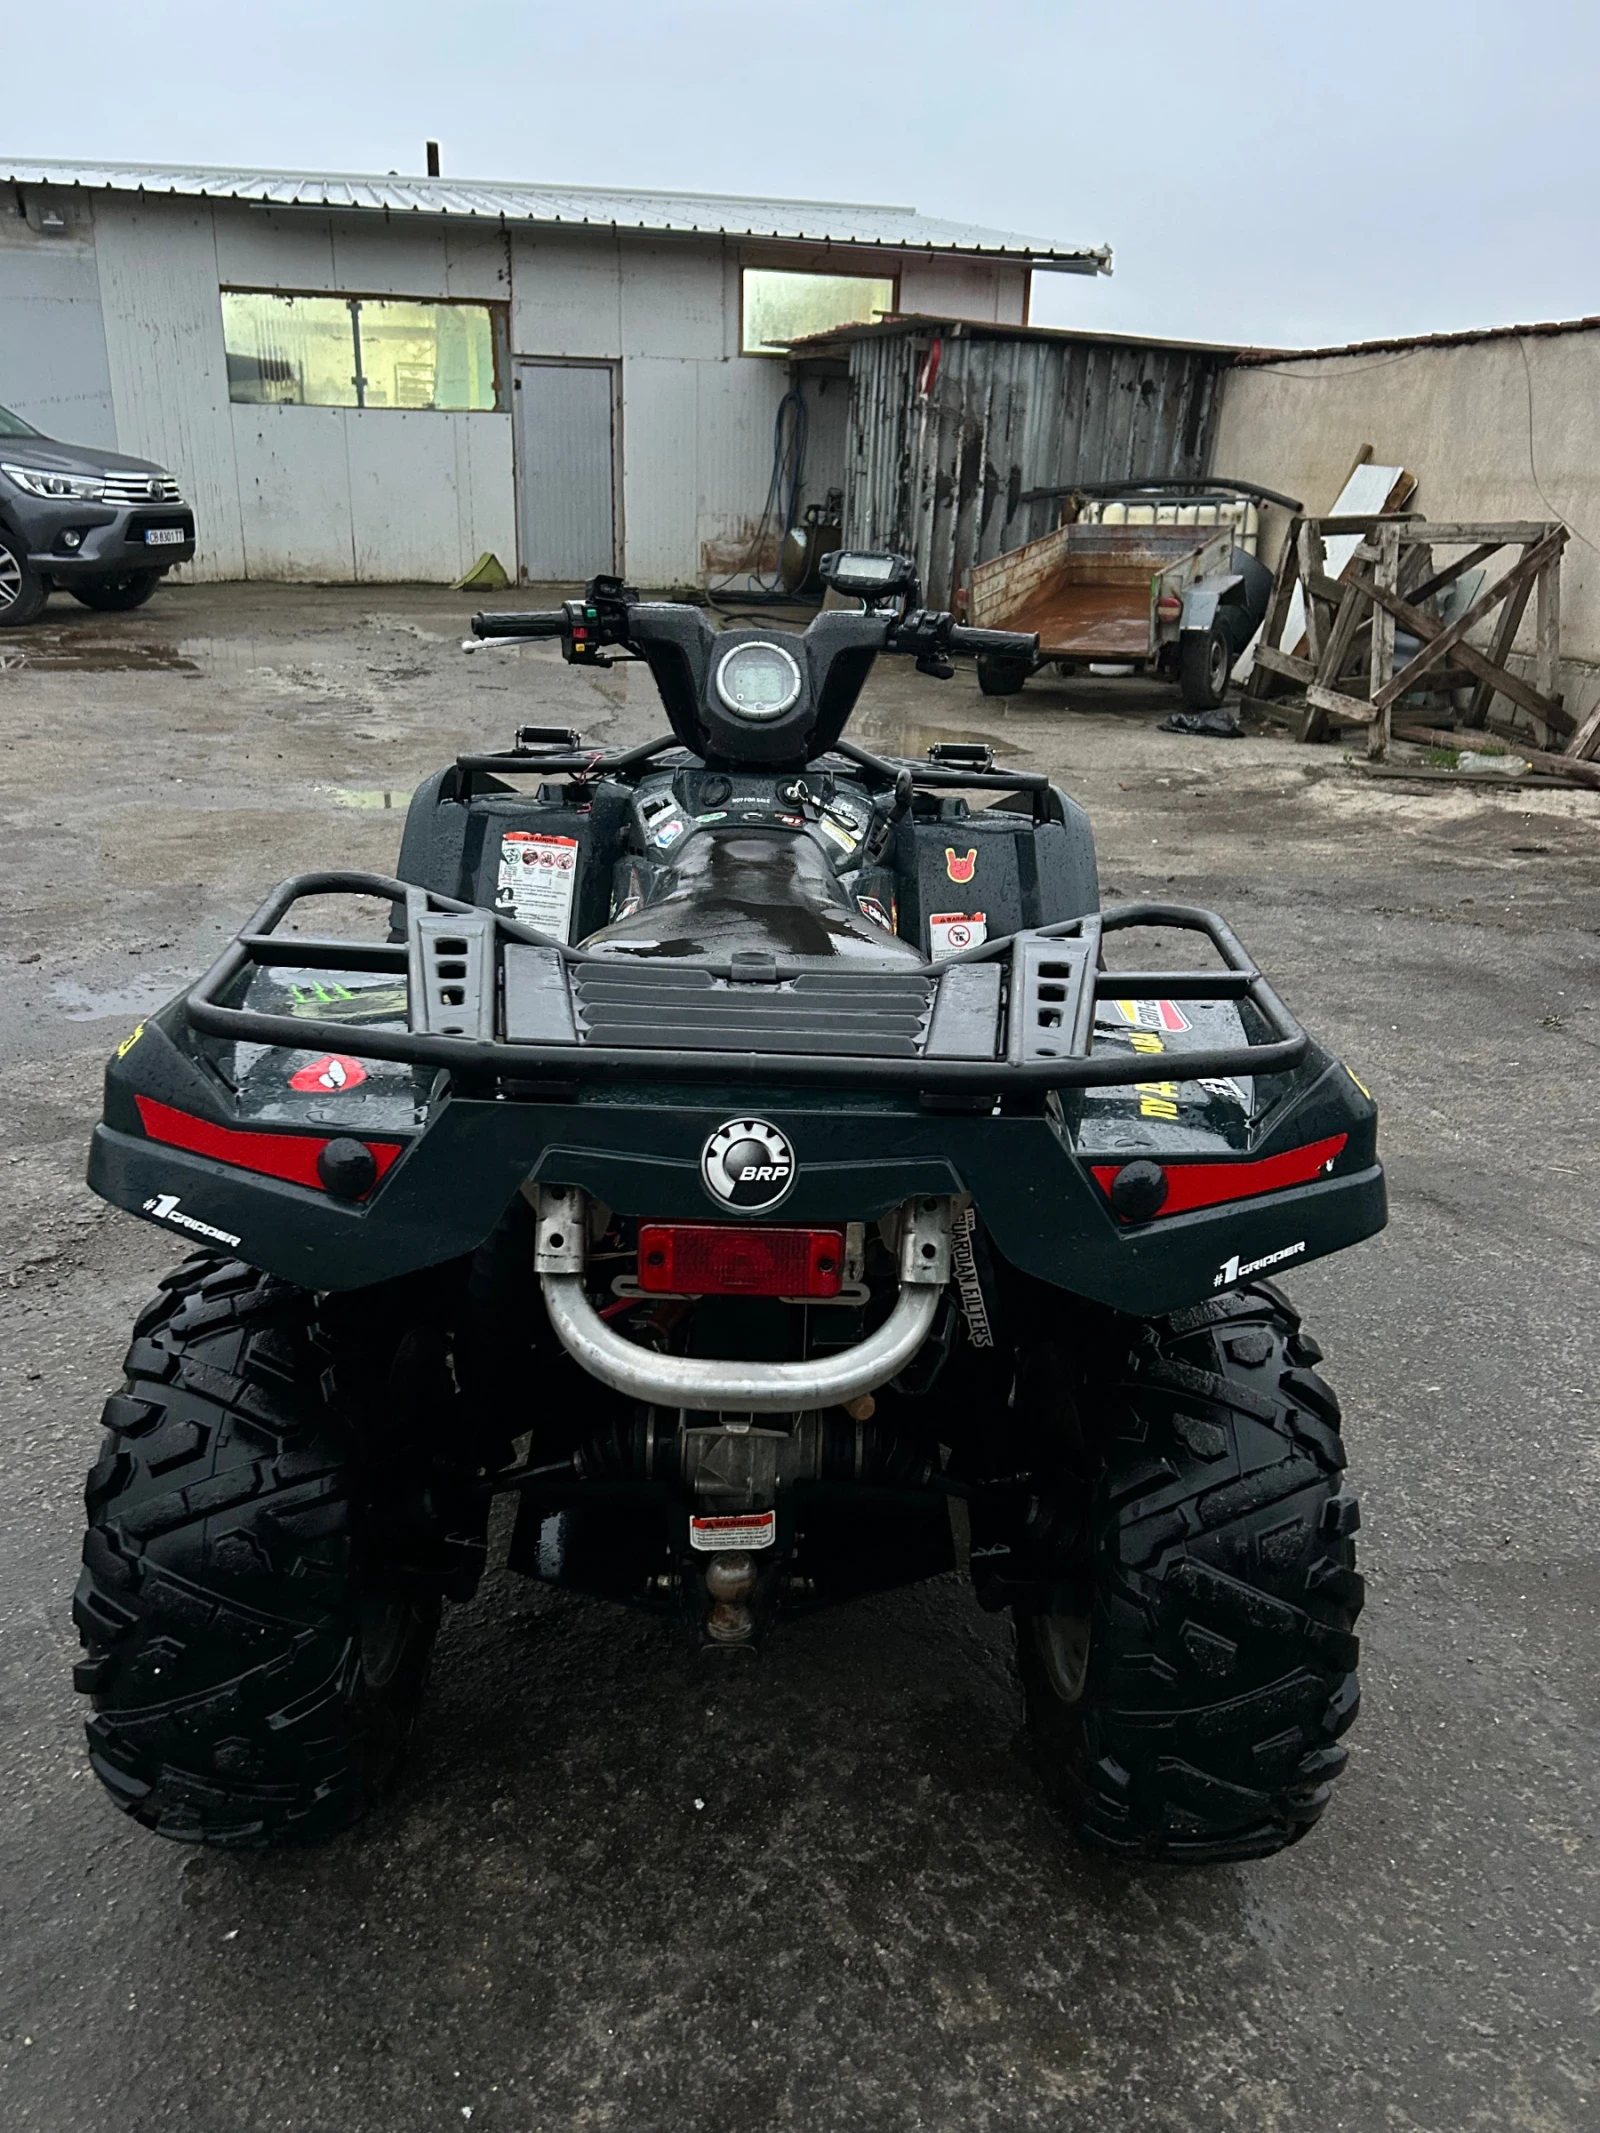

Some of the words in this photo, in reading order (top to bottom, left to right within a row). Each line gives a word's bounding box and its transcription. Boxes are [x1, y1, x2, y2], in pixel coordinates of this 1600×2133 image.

[150, 531, 158, 542] CB
[160, 531, 174, 542] 8301
[529, 836, 558, 844] WARNING
[1136, 1000, 1161, 1027] can-a
[739, 1166, 789, 1181] BRP
[142, 1193, 181, 1218] #1
[168, 1210, 241, 1247] GRIPPER
[1213, 1255, 1239, 1287] #1
[1238, 1241, 1305, 1276] GRIPPER
[963, 1286, 991, 1345] FILTERS
[716, 1518, 762, 1528] WARNING
